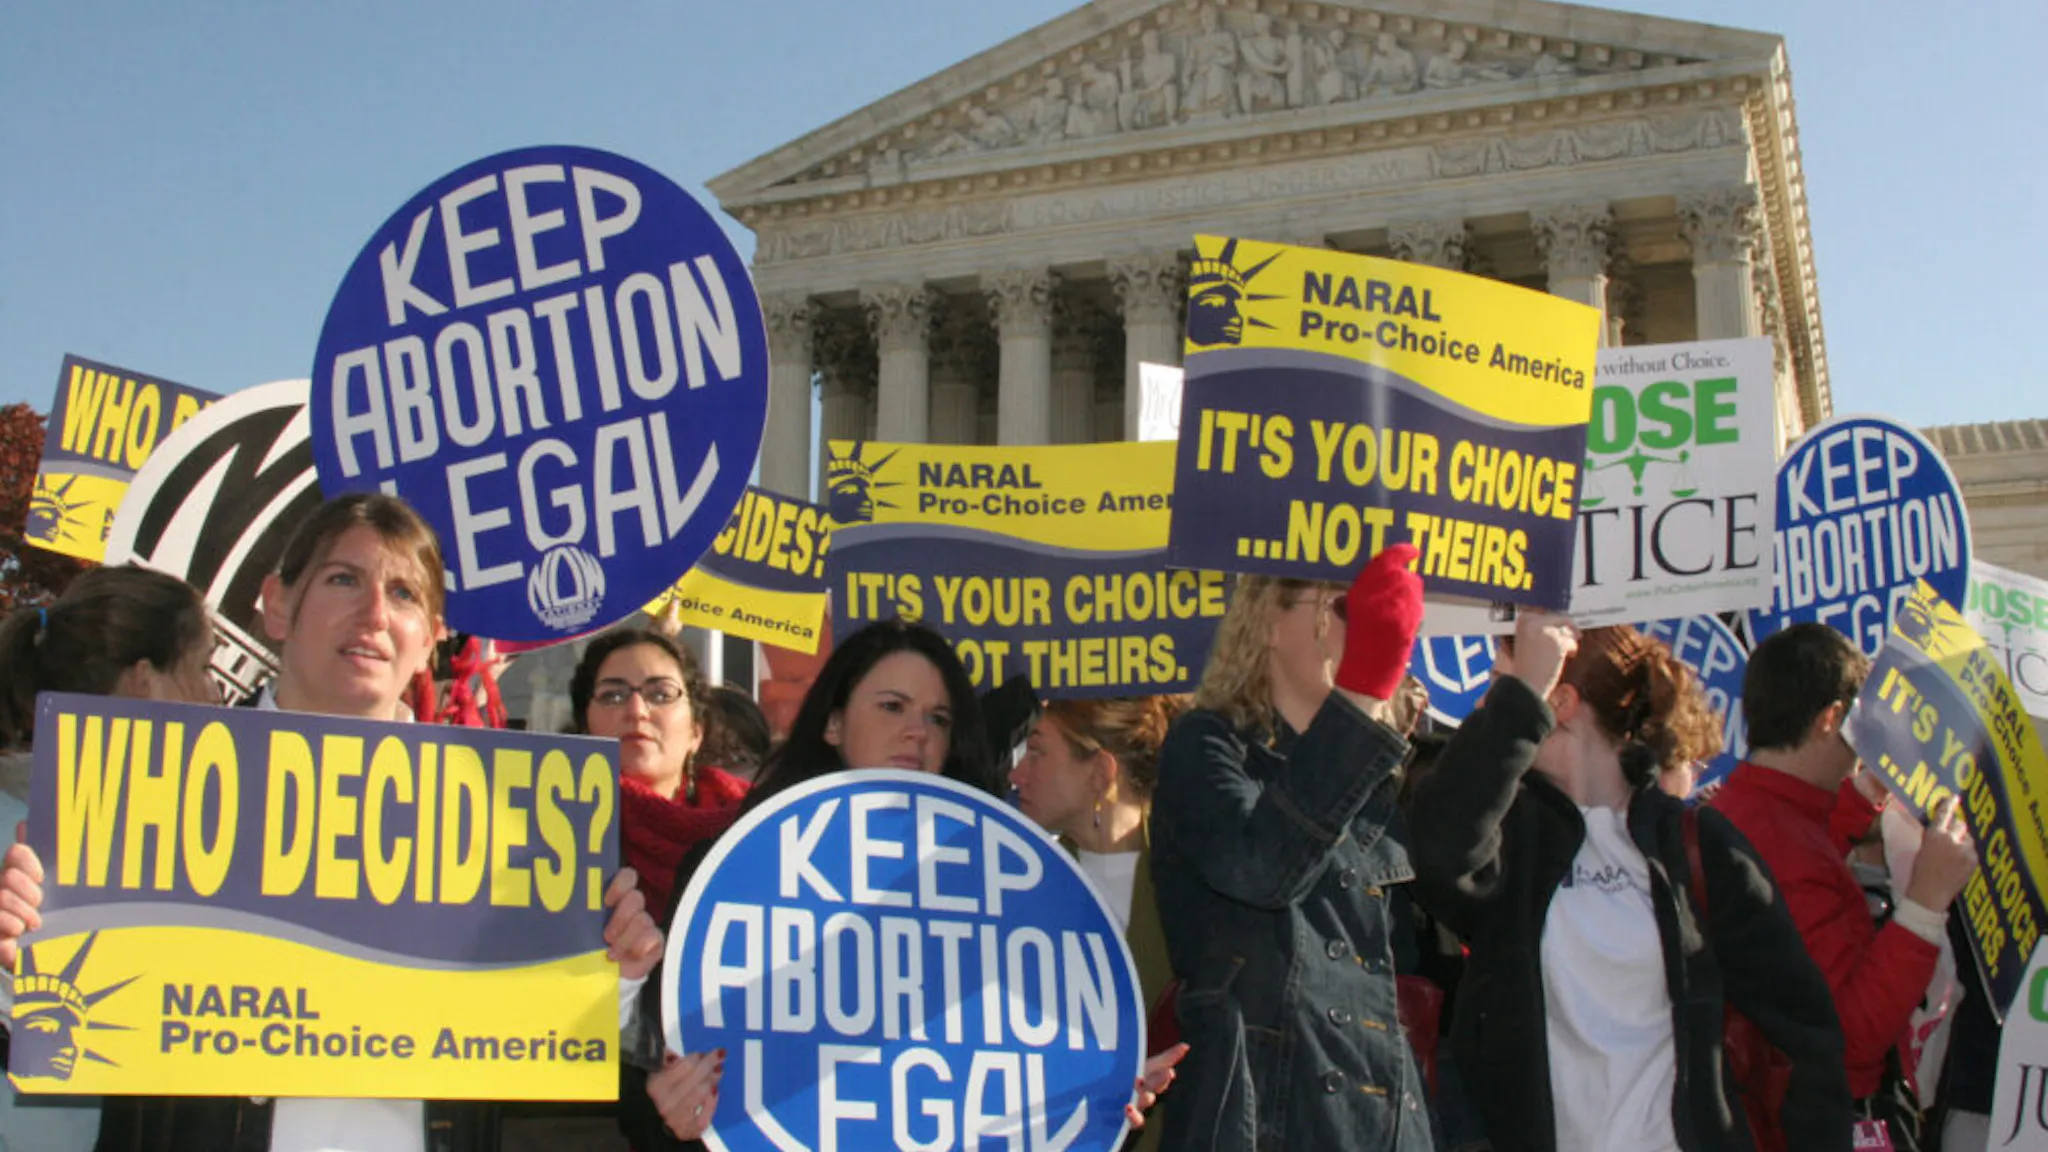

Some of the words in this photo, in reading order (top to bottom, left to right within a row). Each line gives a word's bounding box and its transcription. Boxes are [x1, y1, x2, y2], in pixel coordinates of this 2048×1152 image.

[379, 164, 642, 327] KEEP
[1302, 271, 1441, 322] NARAL
[331, 254, 742, 478] ABORTION
[1300, 311, 1480, 363] Pro-Choice
[1489, 343, 1585, 389] America
[1604, 355, 1667, 376] without
[1671, 352, 1731, 372] Choice.
[60, 364, 161, 471] WHO
[1587, 377, 1740, 455] OSE
[379, 411, 720, 592] EGAL
[918, 491, 1085, 516] Pro-Choice
[919, 461, 1042, 489] NARAL
[1197, 409, 1293, 479] IT'S
[1310, 420, 1440, 495] YOUR
[1448, 440, 1577, 520] CHOICE
[1787, 427, 1918, 521] KEEP
[1405, 511, 1533, 591] THEIRS.
[1577, 492, 1759, 588] TICE
[1773, 493, 1958, 612] ABORTION
[731, 608, 814, 640] America
[846, 572, 922, 623] IT'S
[935, 571, 1051, 627] YOUR
[1064, 569, 1226, 625] CHOICE
[946, 638, 1010, 689] OT
[1023, 633, 1188, 689] THEIRS.
[1967, 650, 2028, 748] NARAL
[57, 712, 240, 897] WHO
[261, 729, 614, 913] DECIDES?
[779, 791, 1044, 918] KEEP
[1877, 666, 1939, 743] IT'S
[1938, 728, 1997, 840] YOUR
[1986, 828, 2038, 963] CHOICE
[161, 983, 320, 1021] NARAL
[701, 902, 1119, 1051] ABORTION
[159, 1022, 414, 1060] Pro-Choice
[432, 1028, 607, 1064] America
[744, 1039, 1088, 1152] LEGAL
